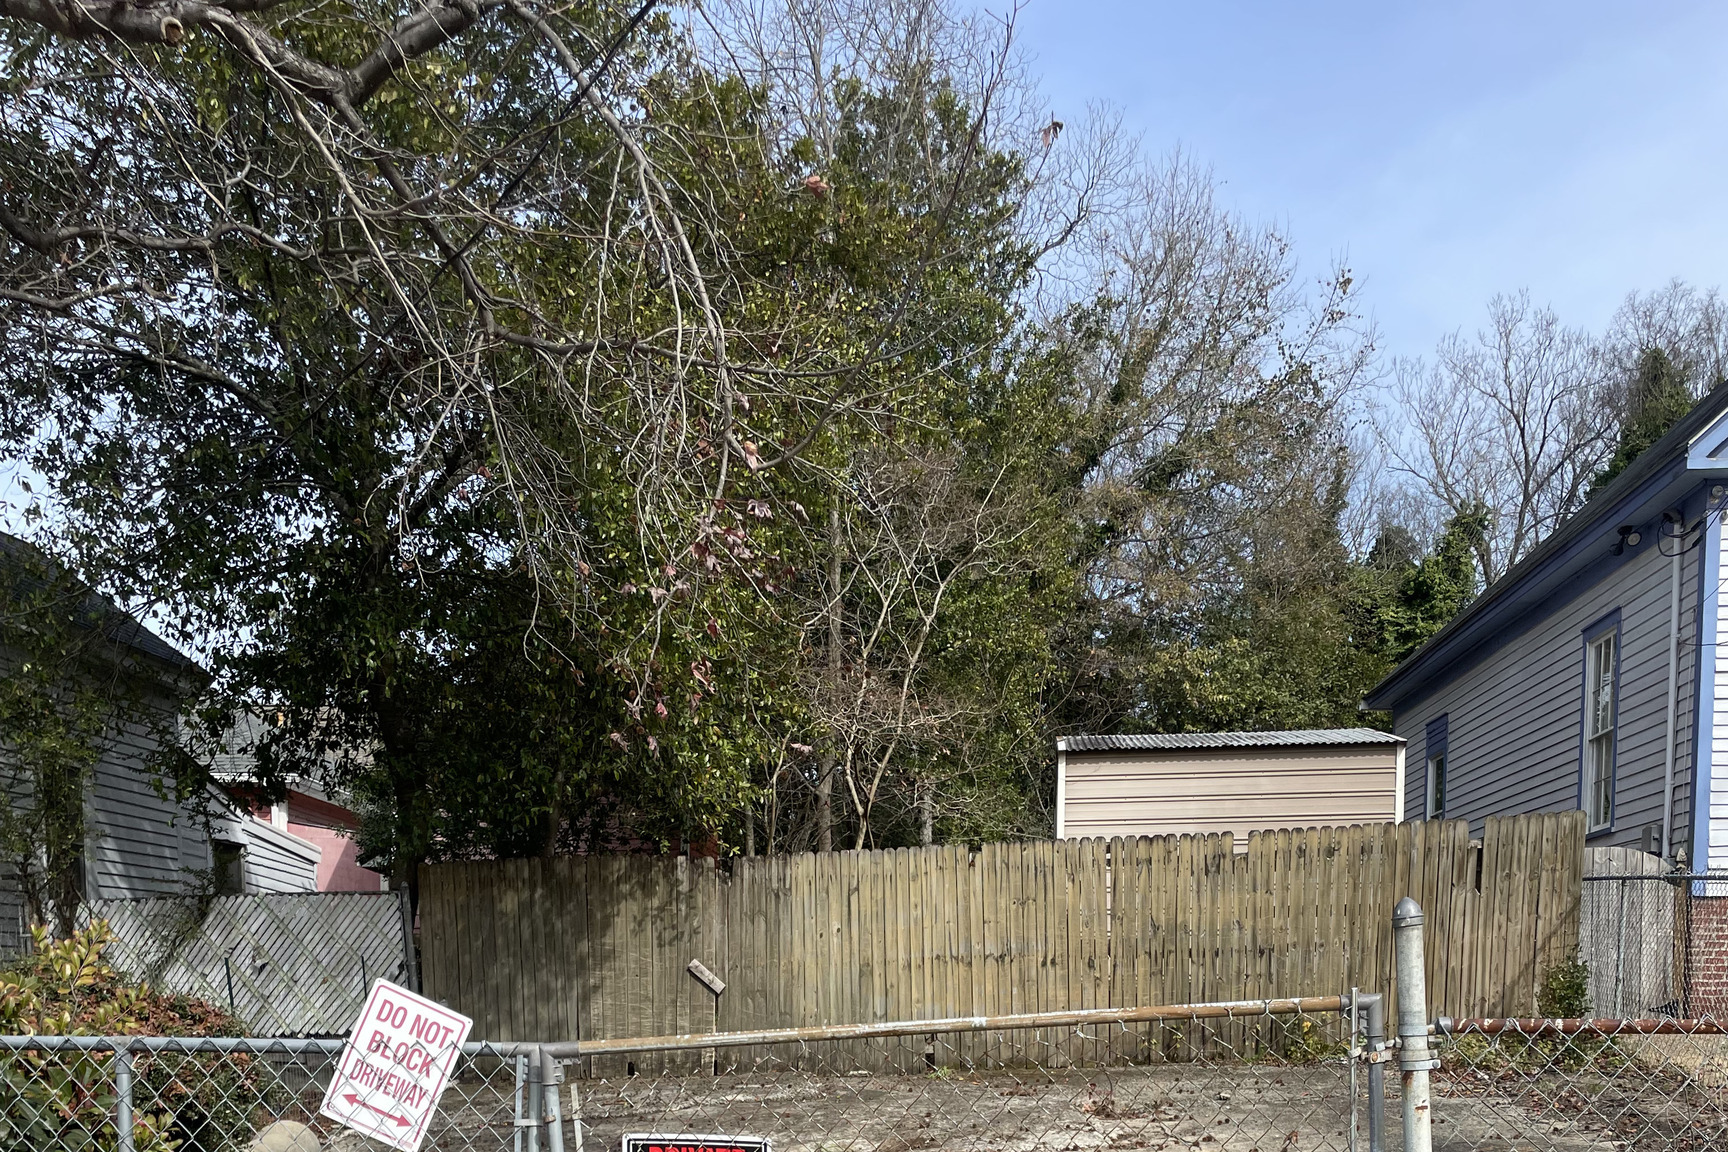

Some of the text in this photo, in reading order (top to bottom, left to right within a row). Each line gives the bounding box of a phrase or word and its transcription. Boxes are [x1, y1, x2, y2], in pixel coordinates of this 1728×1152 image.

[376, 999, 454, 1049] DO NOT
[366, 1030, 436, 1078] BLOCK
[349, 1058, 429, 1109] DRIVEWAY
